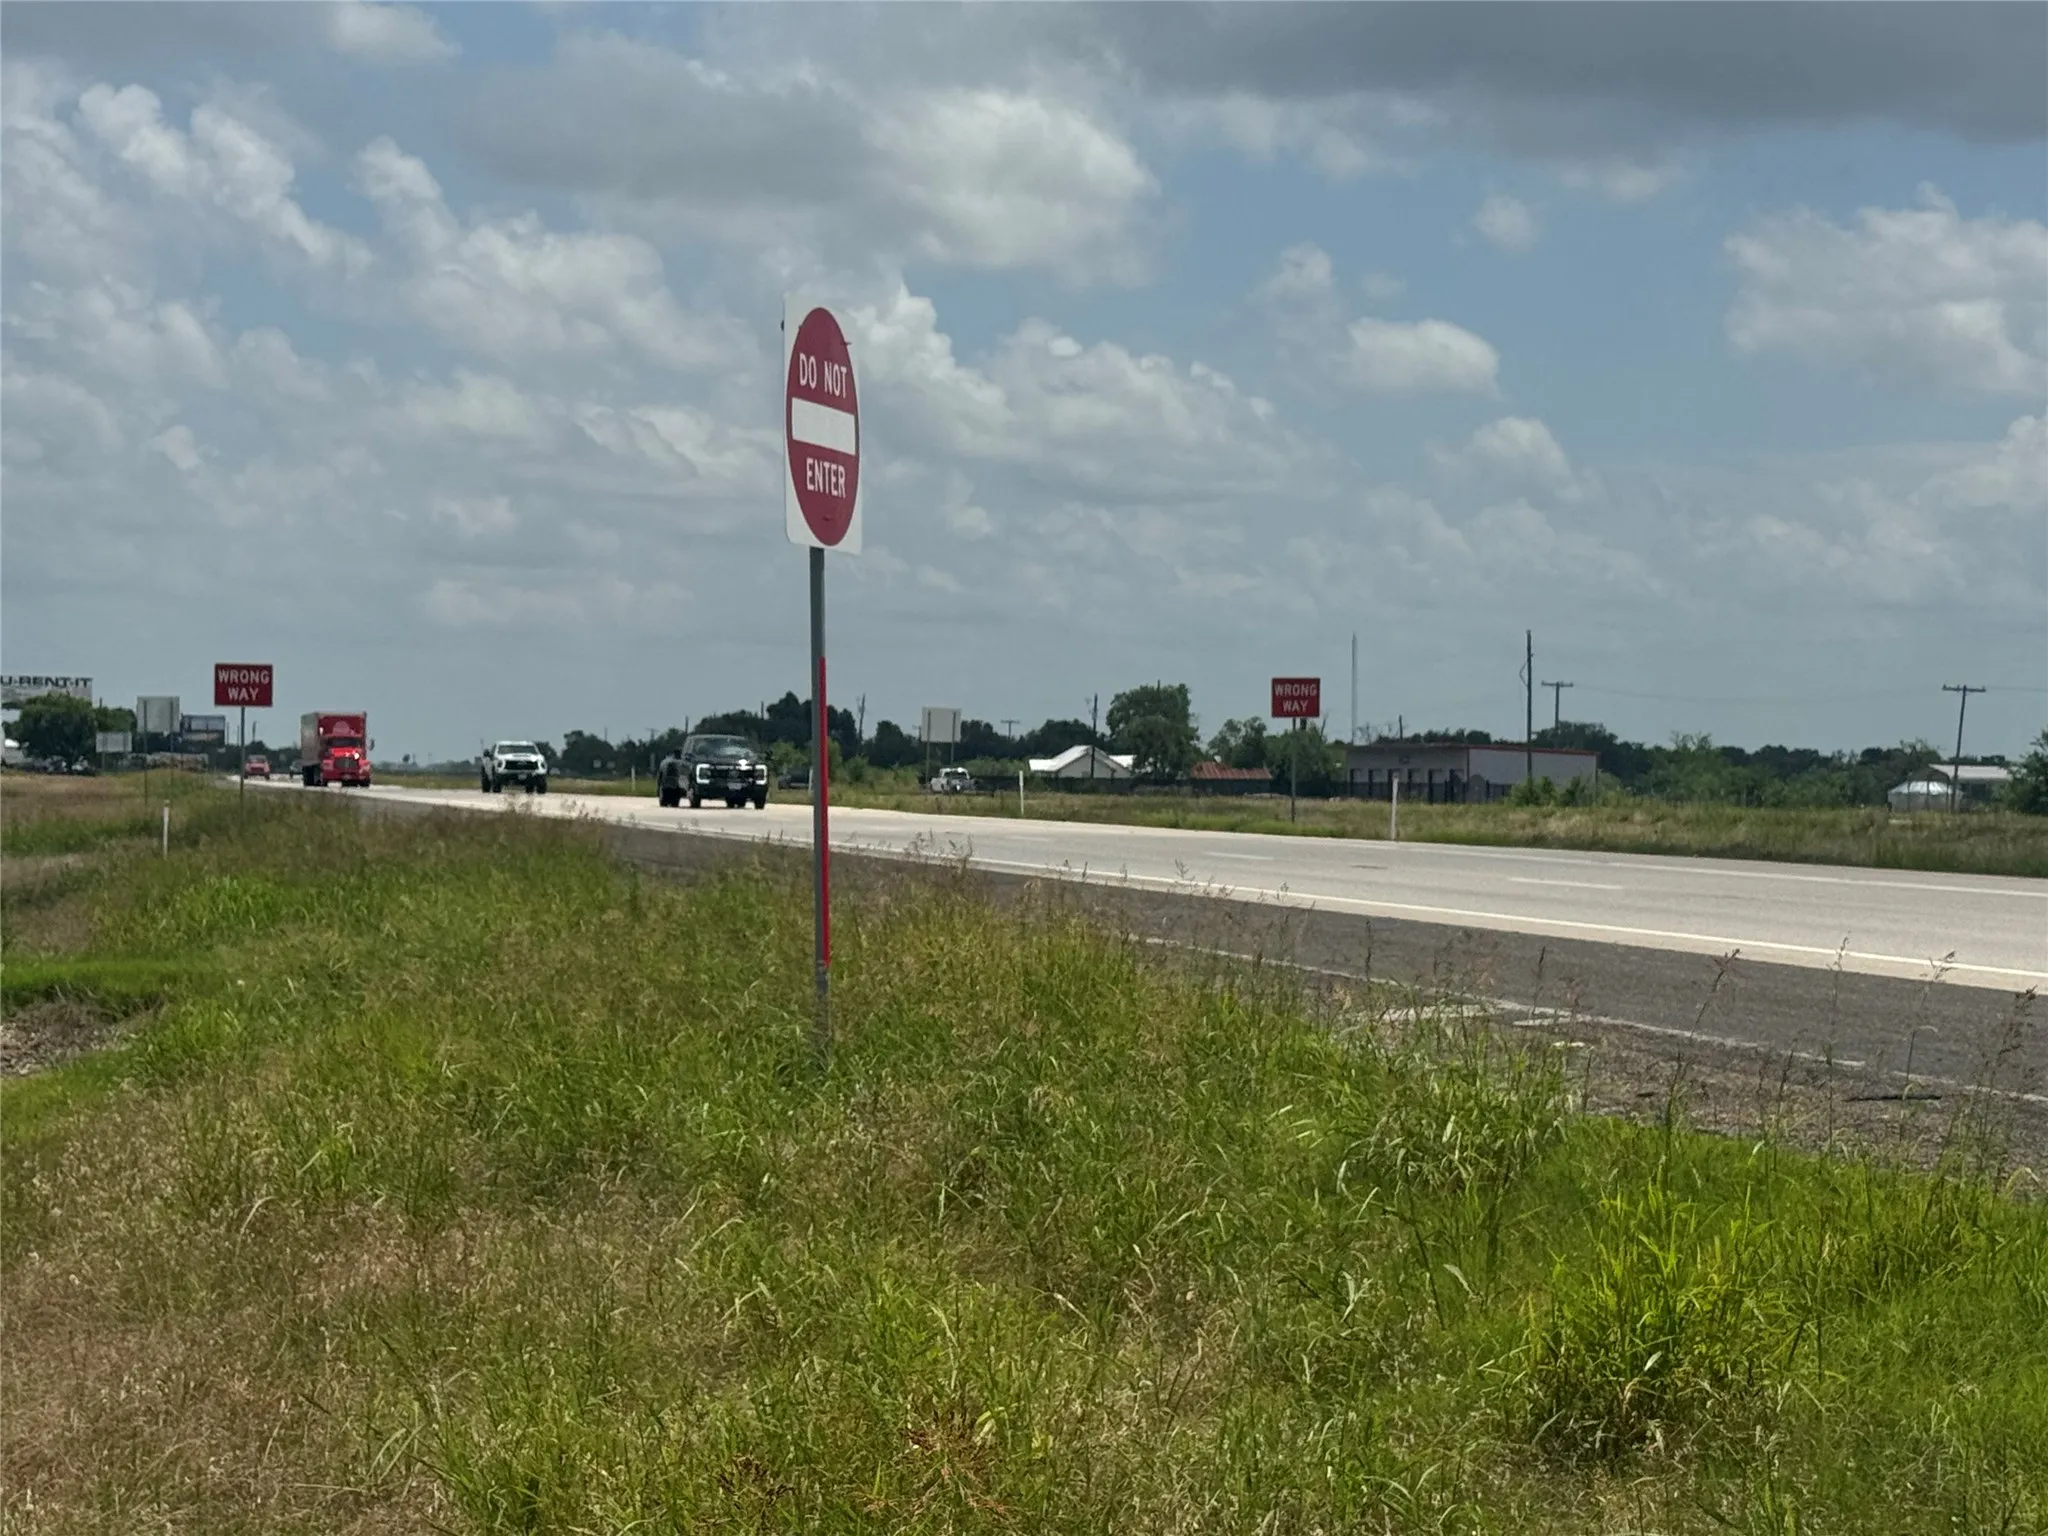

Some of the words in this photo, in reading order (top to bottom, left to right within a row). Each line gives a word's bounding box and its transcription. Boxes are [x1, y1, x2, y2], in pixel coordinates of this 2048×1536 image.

[799, 352, 818, 390] DO
[824, 360, 847, 398] NOT
[806, 457, 847, 499] ENTER
[218, 669, 270, 684] WRONG
[227, 686, 259, 701] WAY
[1274, 683, 1317, 697] WRONG
[1282, 699, 1308, 712] WAY
